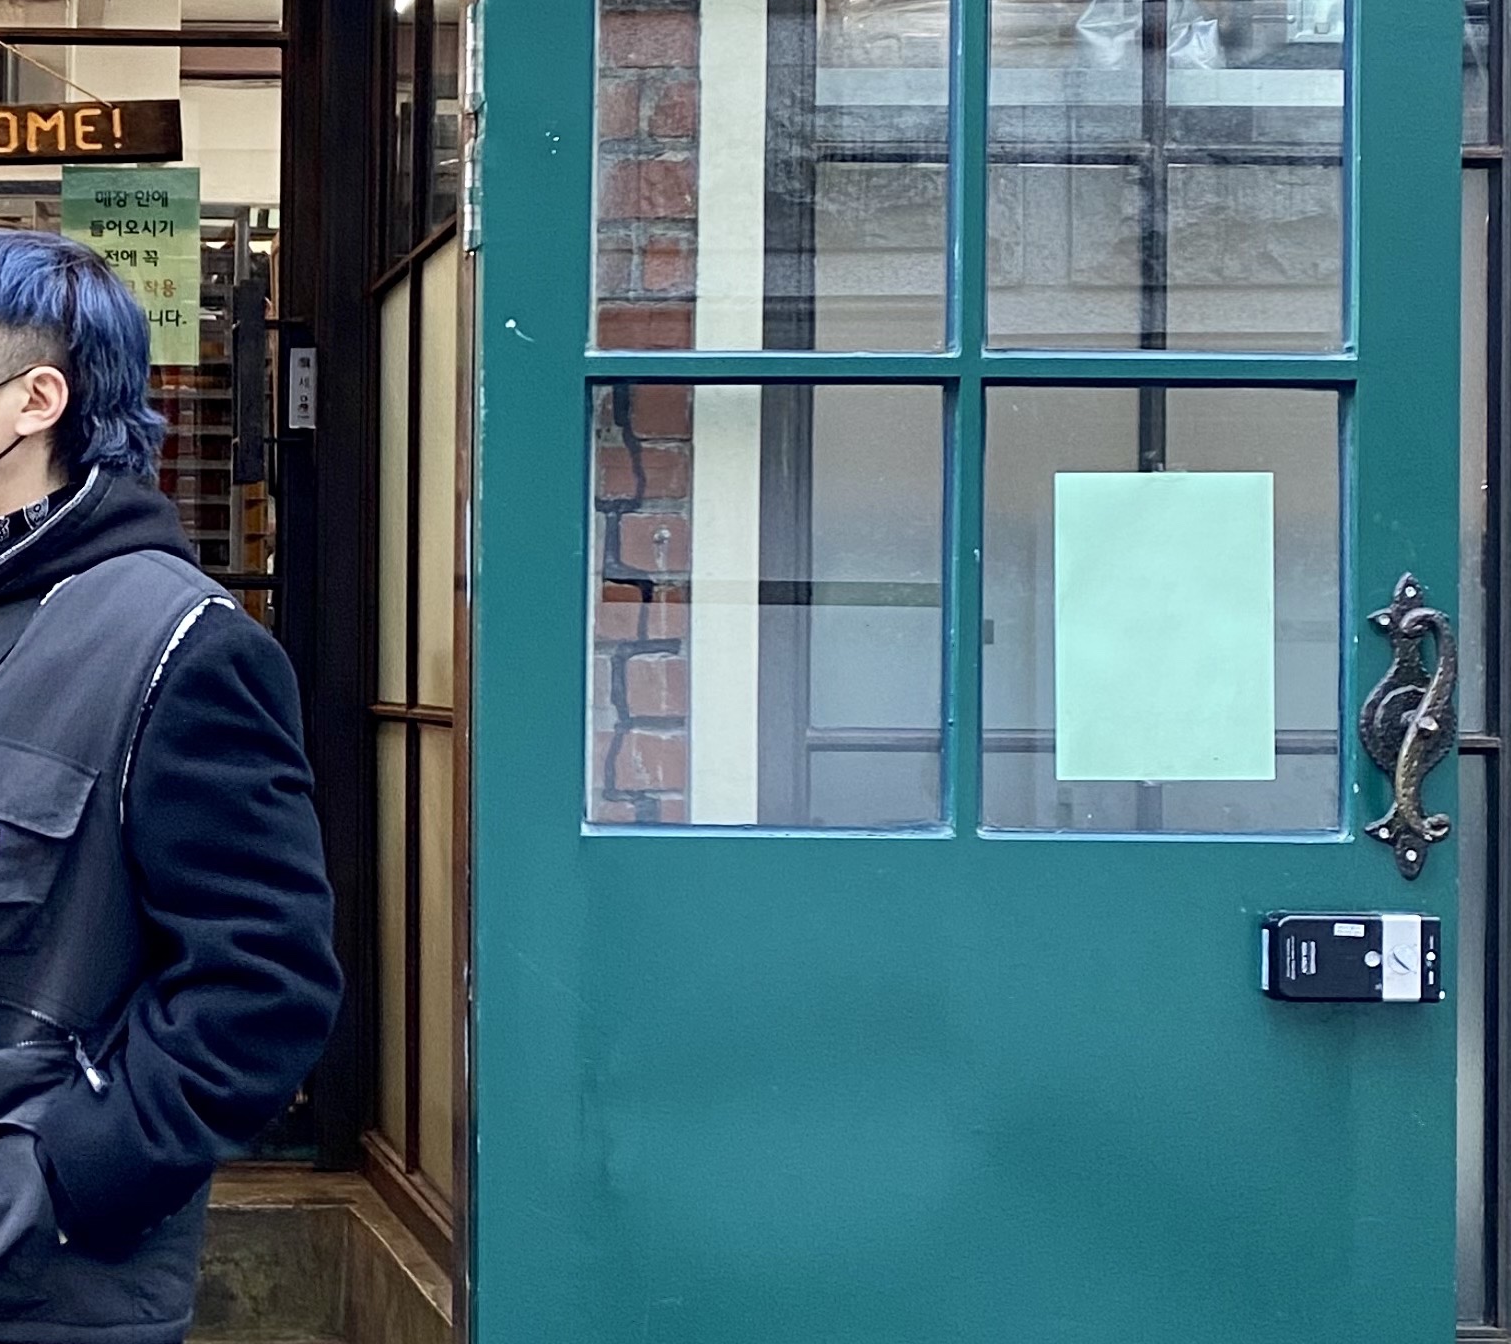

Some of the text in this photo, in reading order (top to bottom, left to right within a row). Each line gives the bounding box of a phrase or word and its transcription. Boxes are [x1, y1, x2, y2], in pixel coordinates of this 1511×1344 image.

[95, 190, 168, 208] 매장 안에
[90, 220, 174, 237] 들어오시기
[105, 250, 159, 267] 전에 꼭
